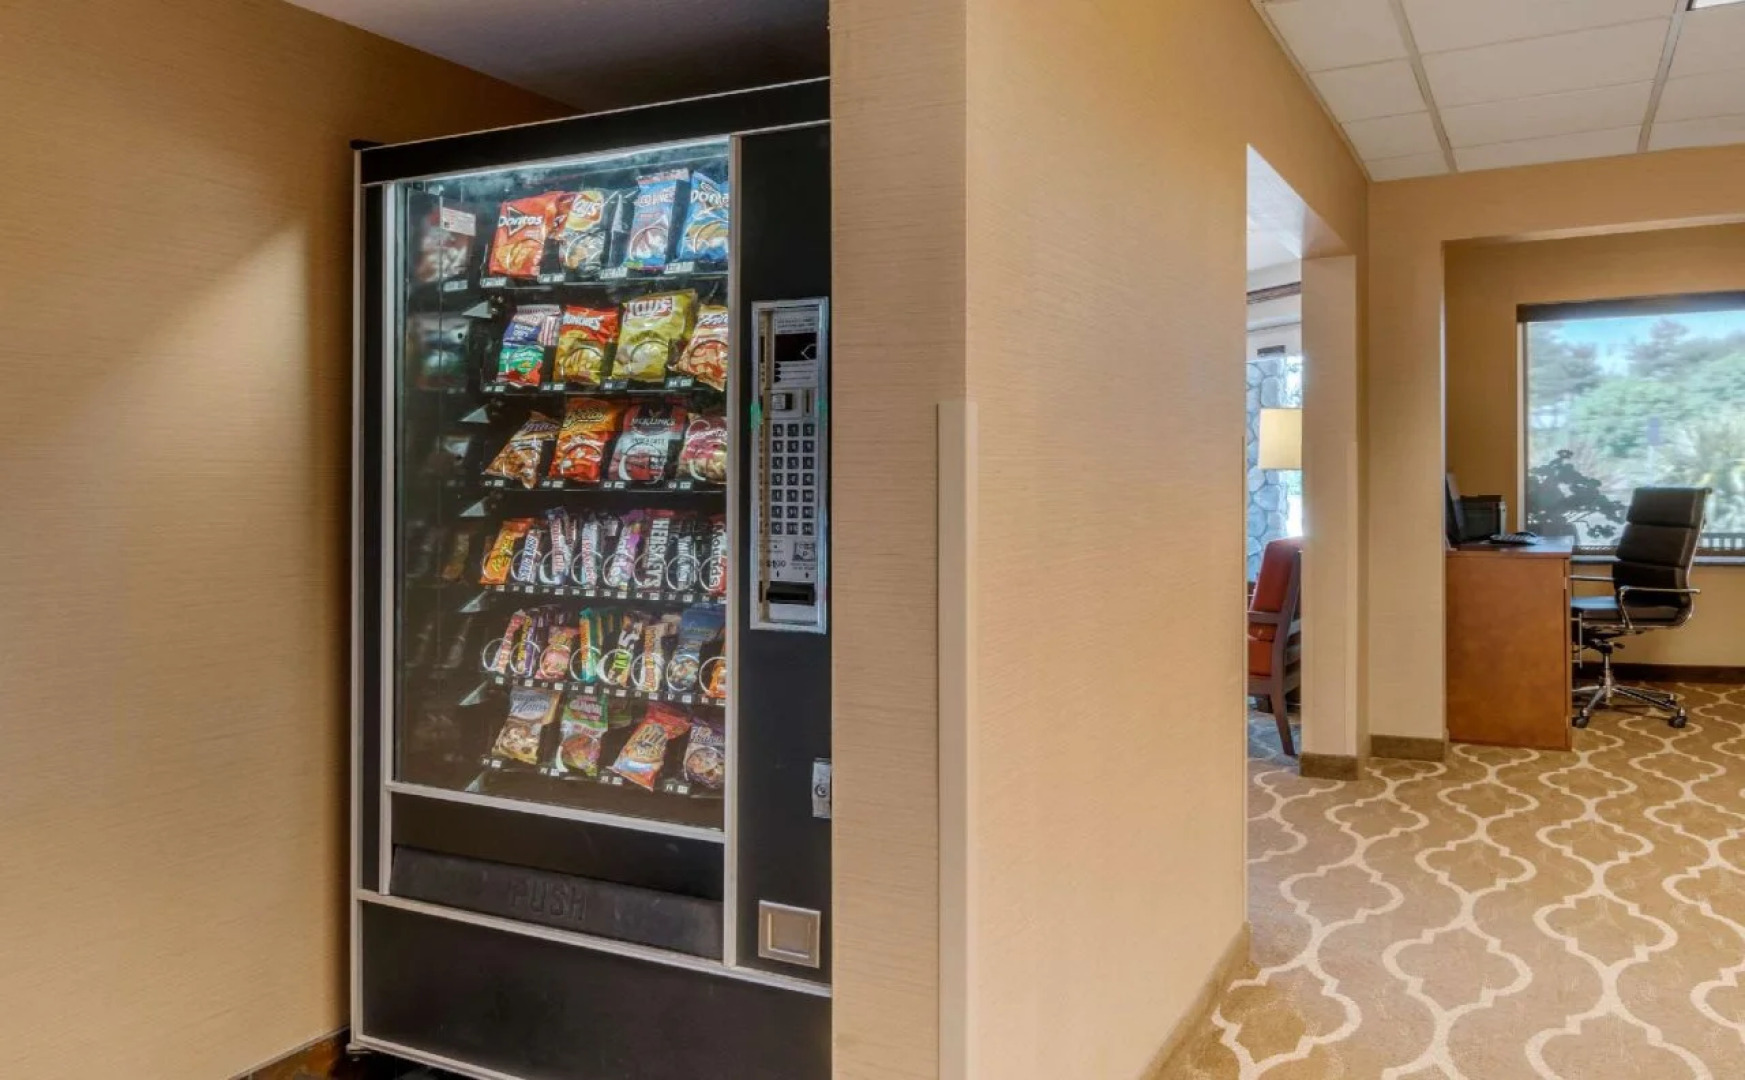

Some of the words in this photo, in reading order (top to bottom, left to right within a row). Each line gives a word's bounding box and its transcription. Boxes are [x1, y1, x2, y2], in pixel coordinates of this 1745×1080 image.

[498, 214, 544, 228] Doritos
[644, 518, 670, 588] HERSHEY'S
[507, 880, 587, 921] PUSH
